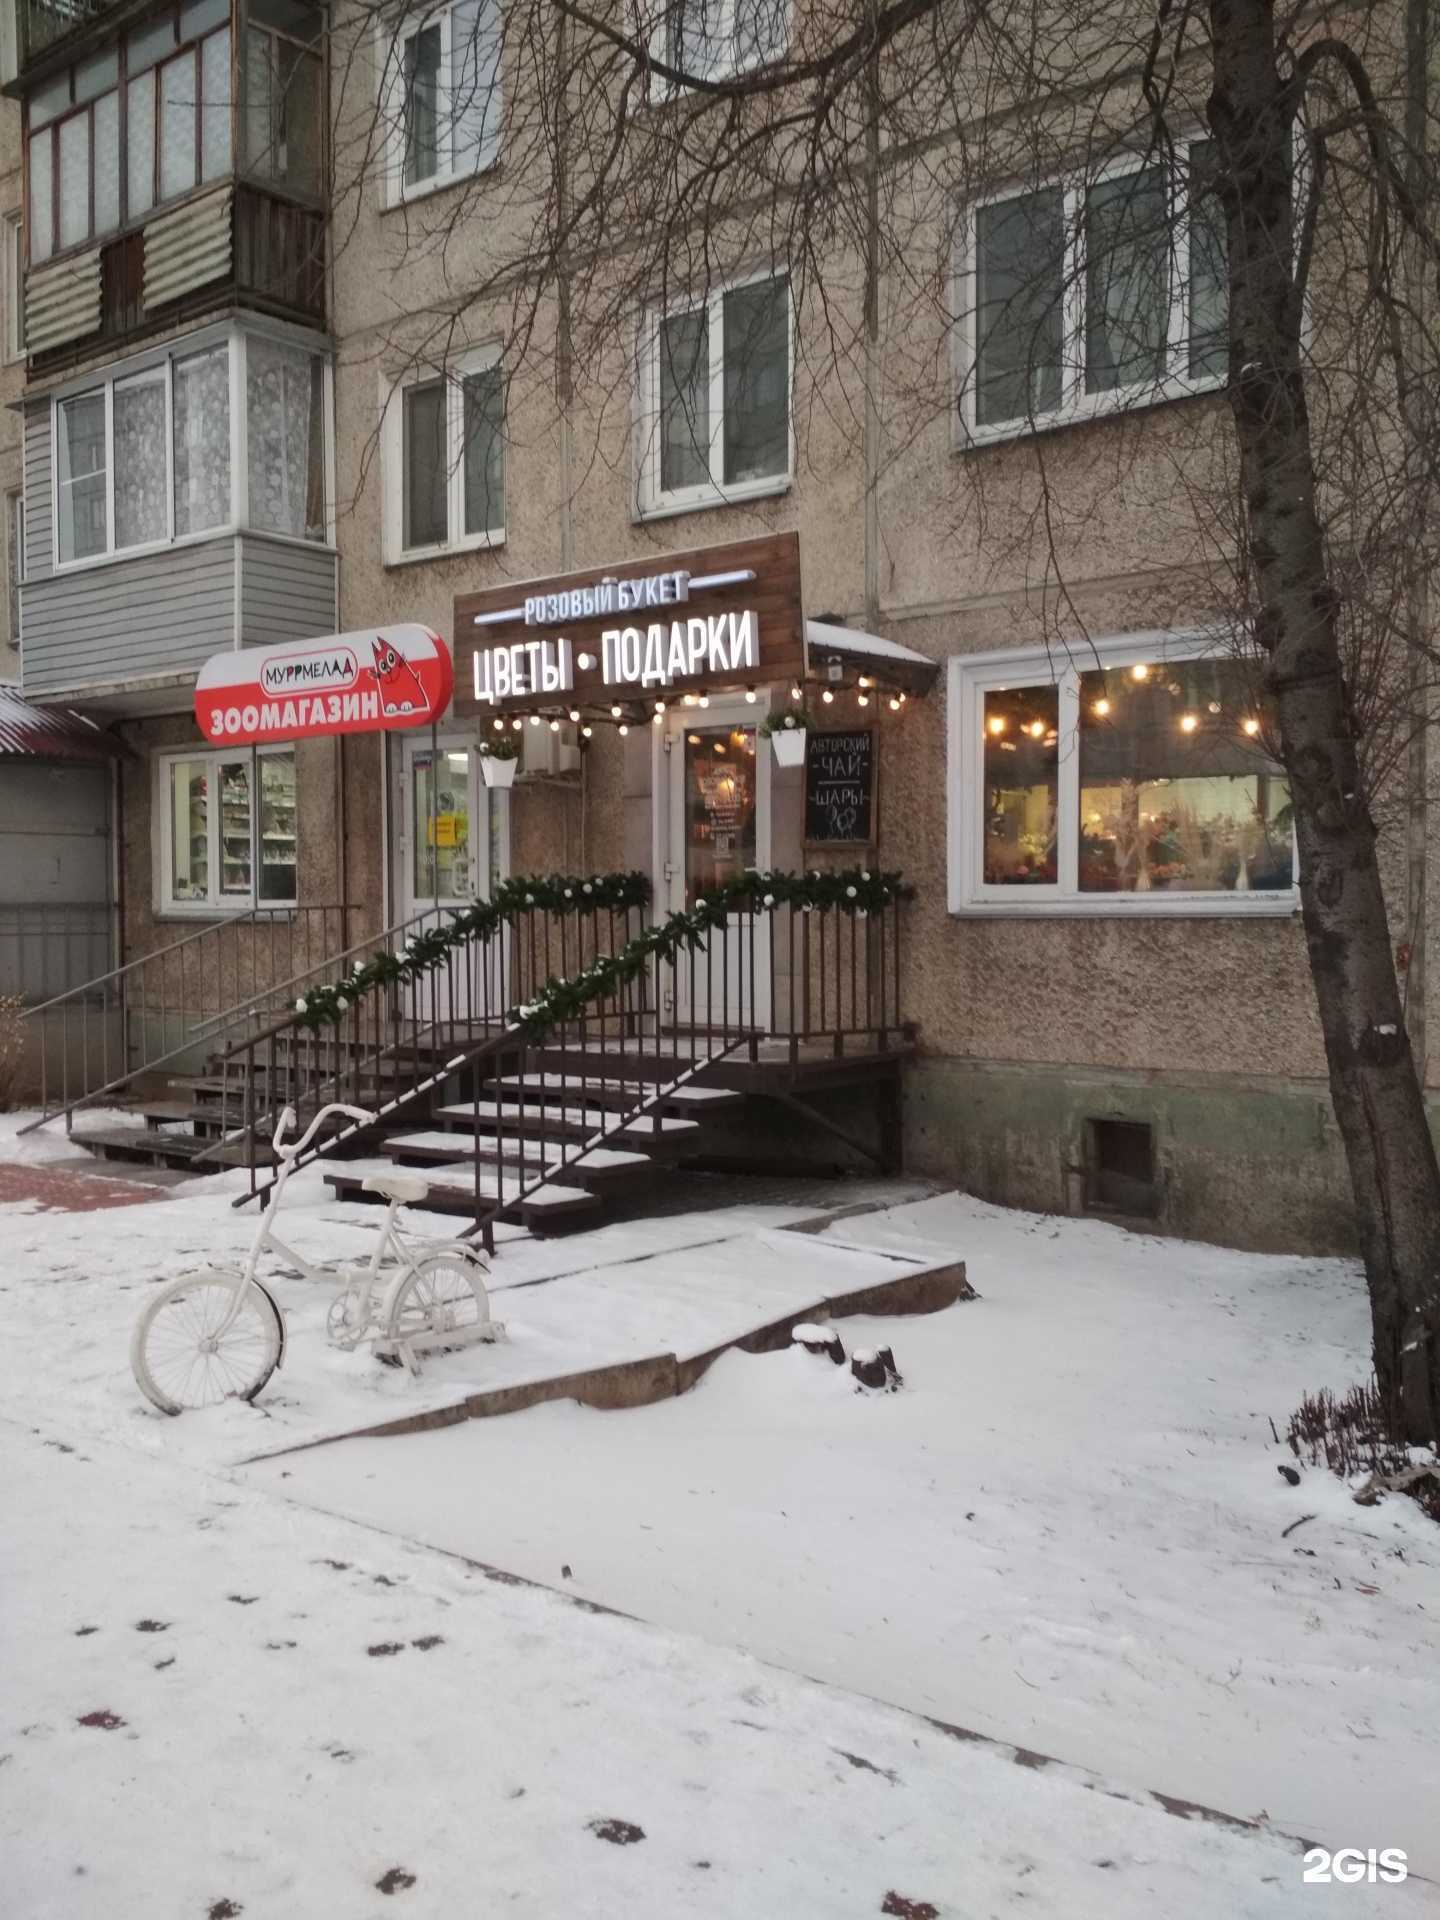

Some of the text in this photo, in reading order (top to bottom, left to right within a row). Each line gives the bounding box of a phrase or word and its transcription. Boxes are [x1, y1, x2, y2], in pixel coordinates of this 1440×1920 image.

[525, 571, 687, 625] РОЗОВЫЙ БУКЕТ
[265, 656, 354, 685] МУРРМЕЛАД
[473, 610, 757, 705] ЦВЕТЫ ПОДАРКИ
[210, 690, 379, 736] ЗООМАГАЗИН
